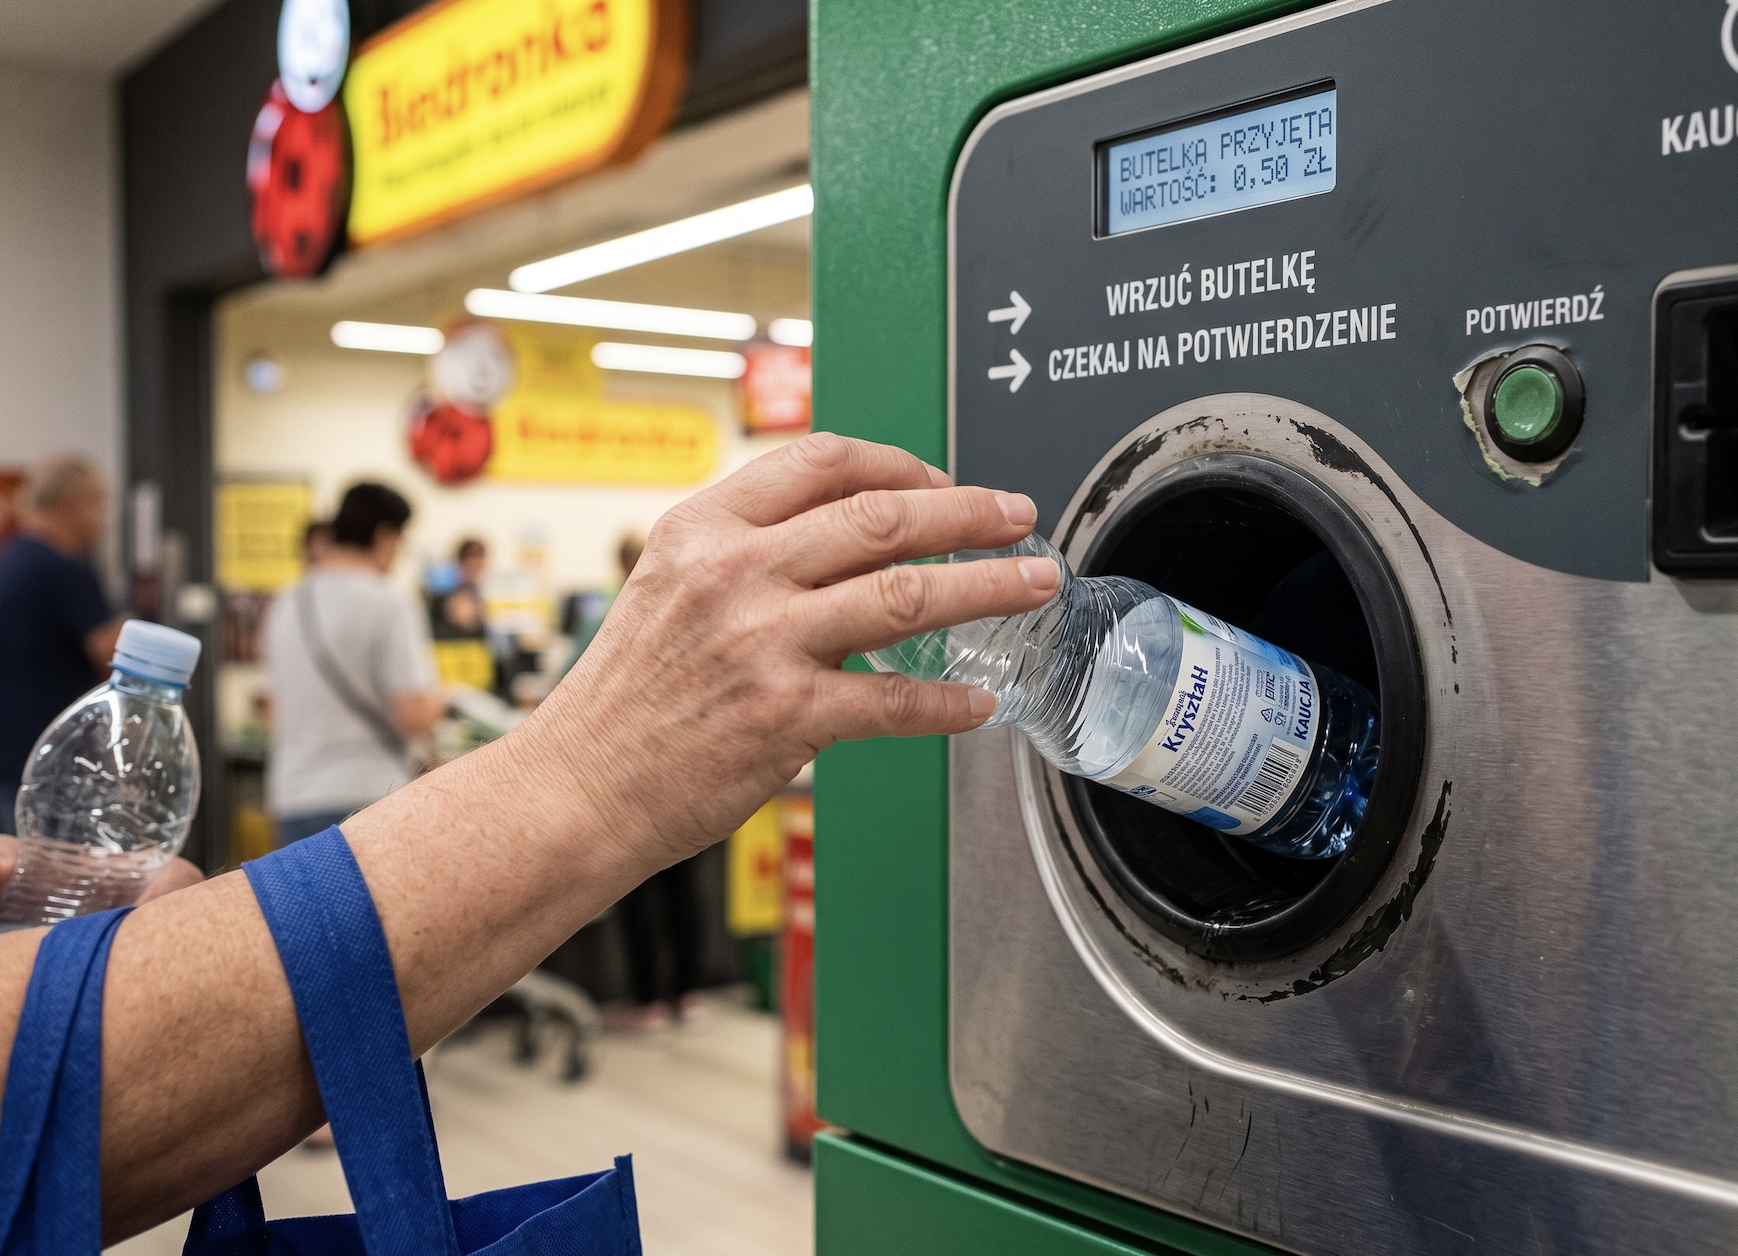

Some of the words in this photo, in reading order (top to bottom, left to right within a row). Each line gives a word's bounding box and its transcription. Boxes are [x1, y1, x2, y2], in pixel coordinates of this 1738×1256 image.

[1120, 138, 1207, 182] BUTELKA
[1220, 107, 1332, 160] PRZYJĘTA
[1661, 104, 1738, 156] KAU
[1120, 166, 1216, 216] WARTOŚĆ:
[1234, 154, 1289, 191] 0,50
[1303, 146, 1333, 177] ZŁ
[1106, 263, 1193, 316] WRZUĆ
[1200, 249, 1316, 302] BUTELKĘ
[1465, 284, 1605, 336] POTWIERDŹ
[1048, 344, 1130, 382] CZEKAJ
[1137, 335, 1171, 371] NA
[1177, 303, 1397, 366] POTWIERDZENIE
[1293, 680, 1312, 741] KAUCJA
